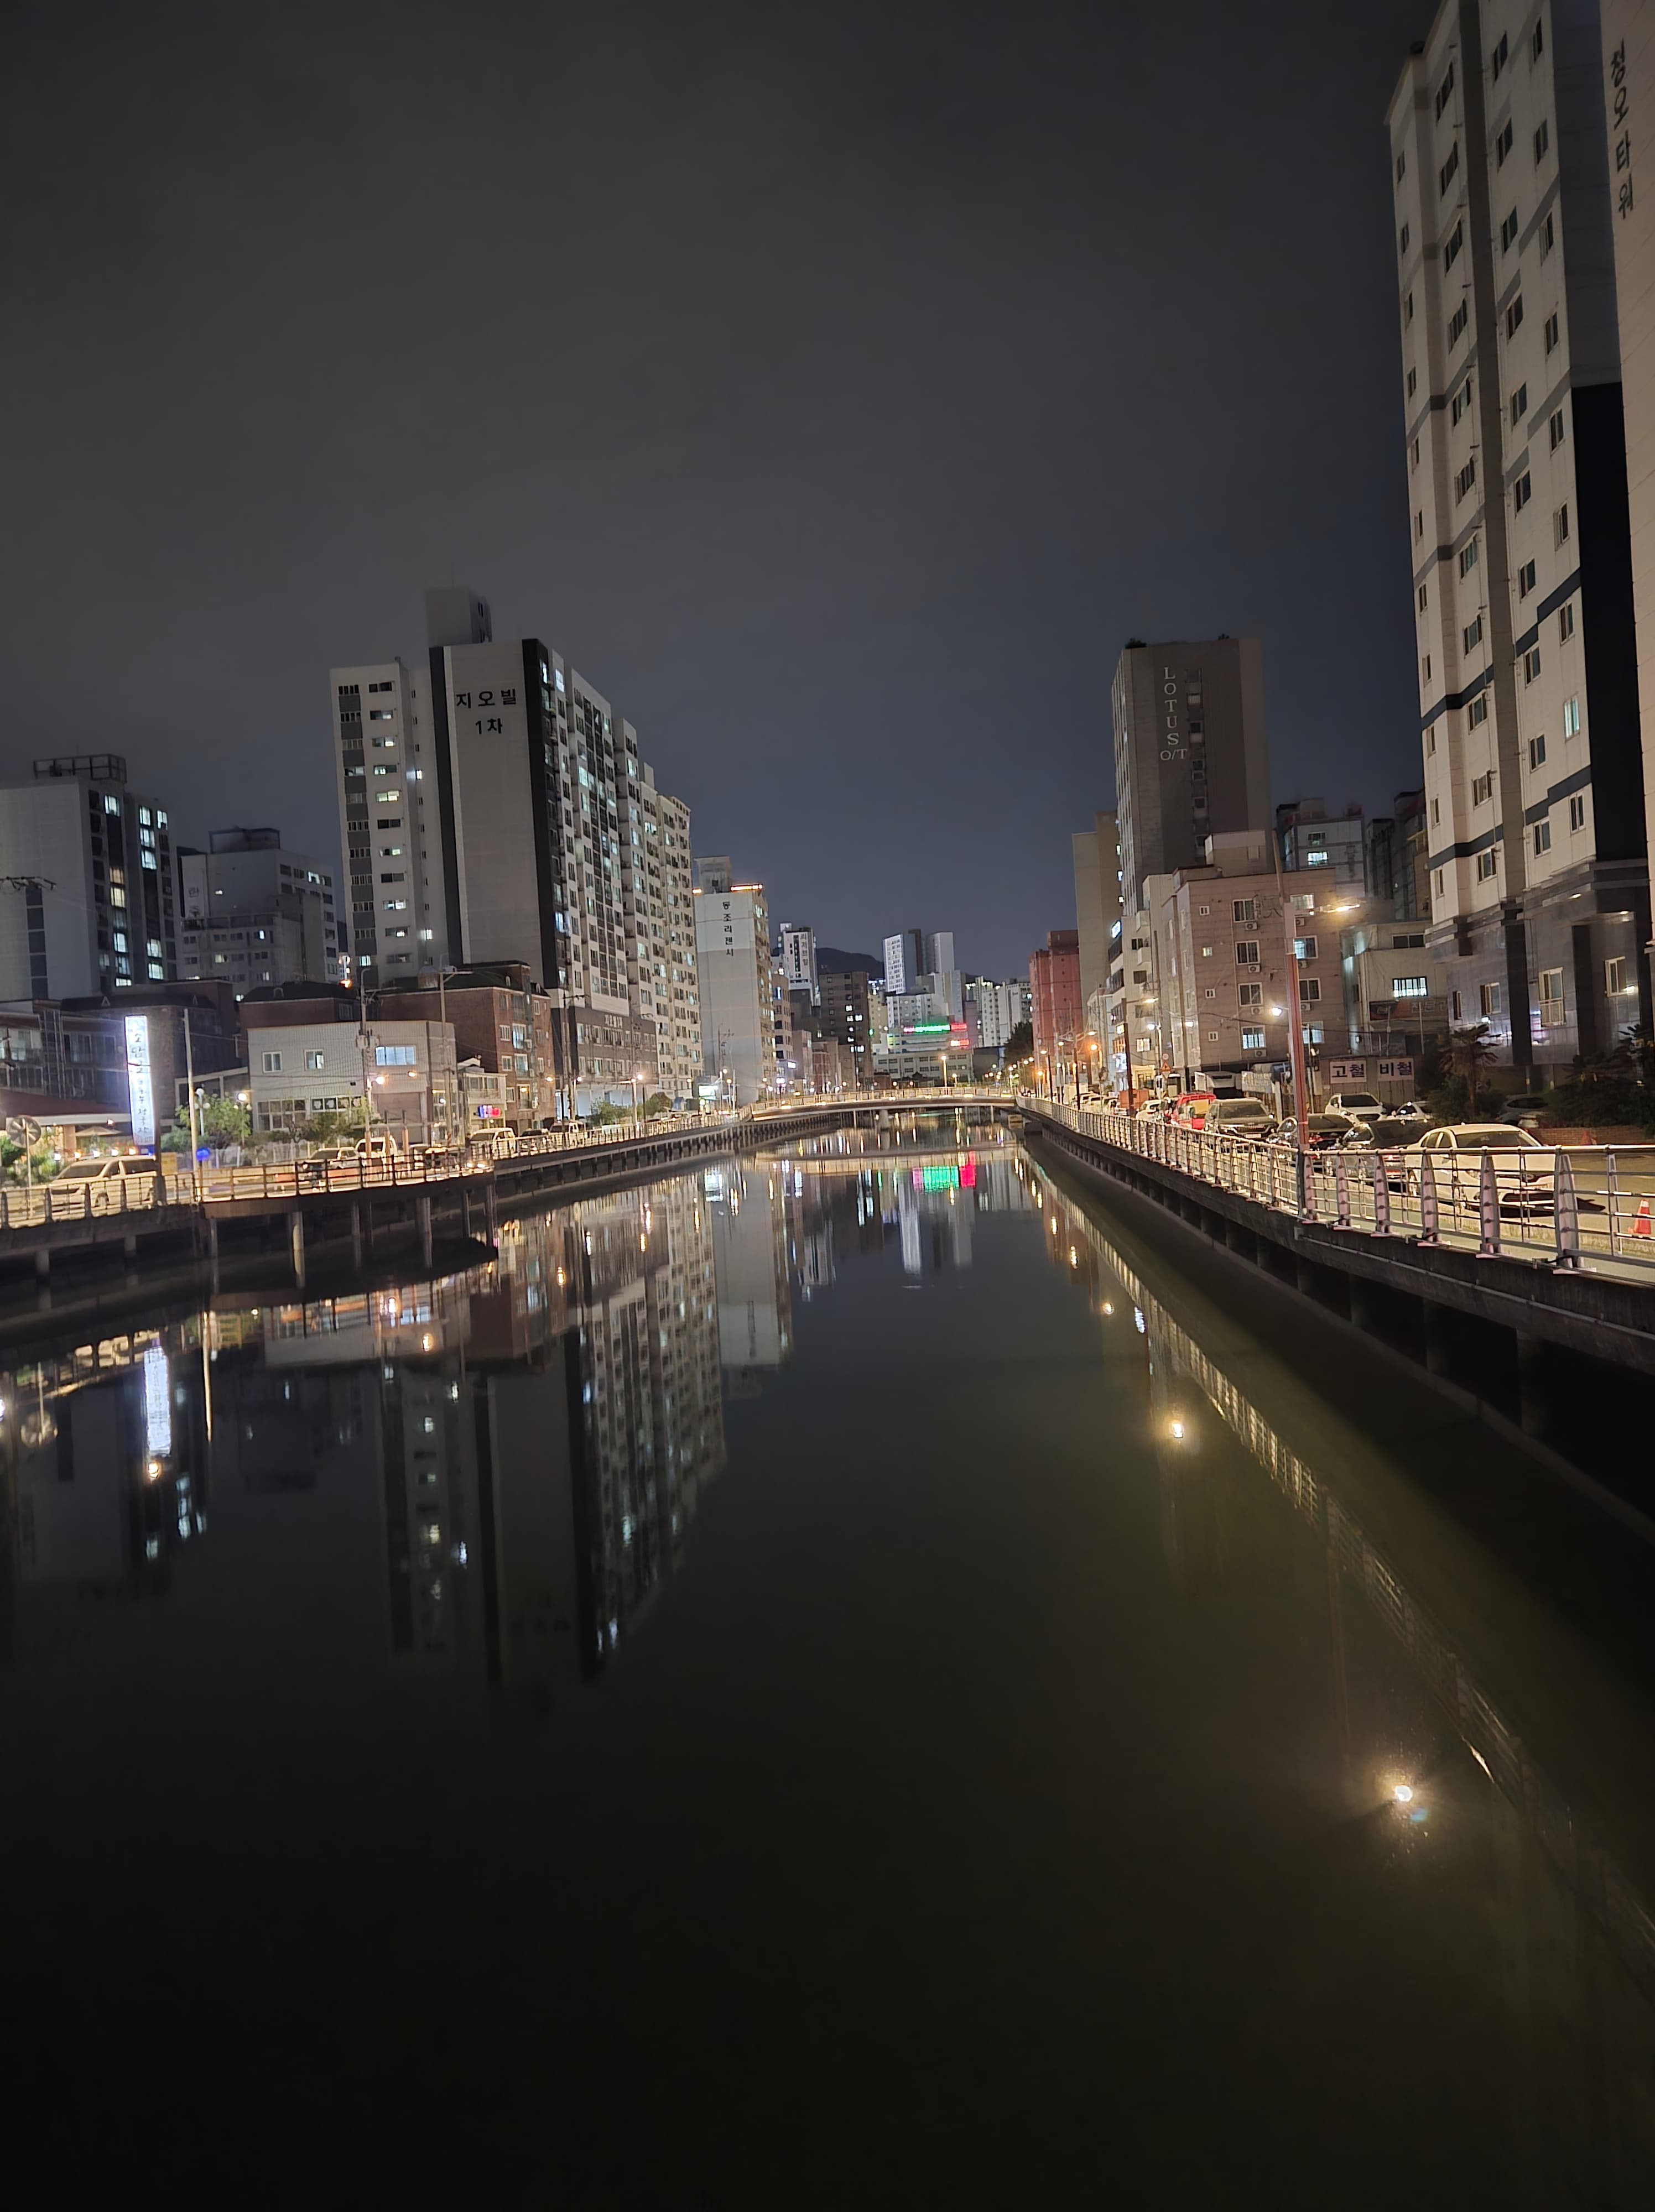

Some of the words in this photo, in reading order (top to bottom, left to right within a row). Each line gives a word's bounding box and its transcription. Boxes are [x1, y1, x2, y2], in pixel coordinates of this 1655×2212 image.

[456, 688, 516, 708] 지오빌
[1164, 667, 1179, 745] LOTUS
[475, 718, 502, 734] 1차
[1160, 749, 1188, 761] O/T
[722, 901, 733, 957] 동조리젠시
[1332, 1064, 1365, 1078] 고철
[1380, 1062, 1412, 1076] 비철
